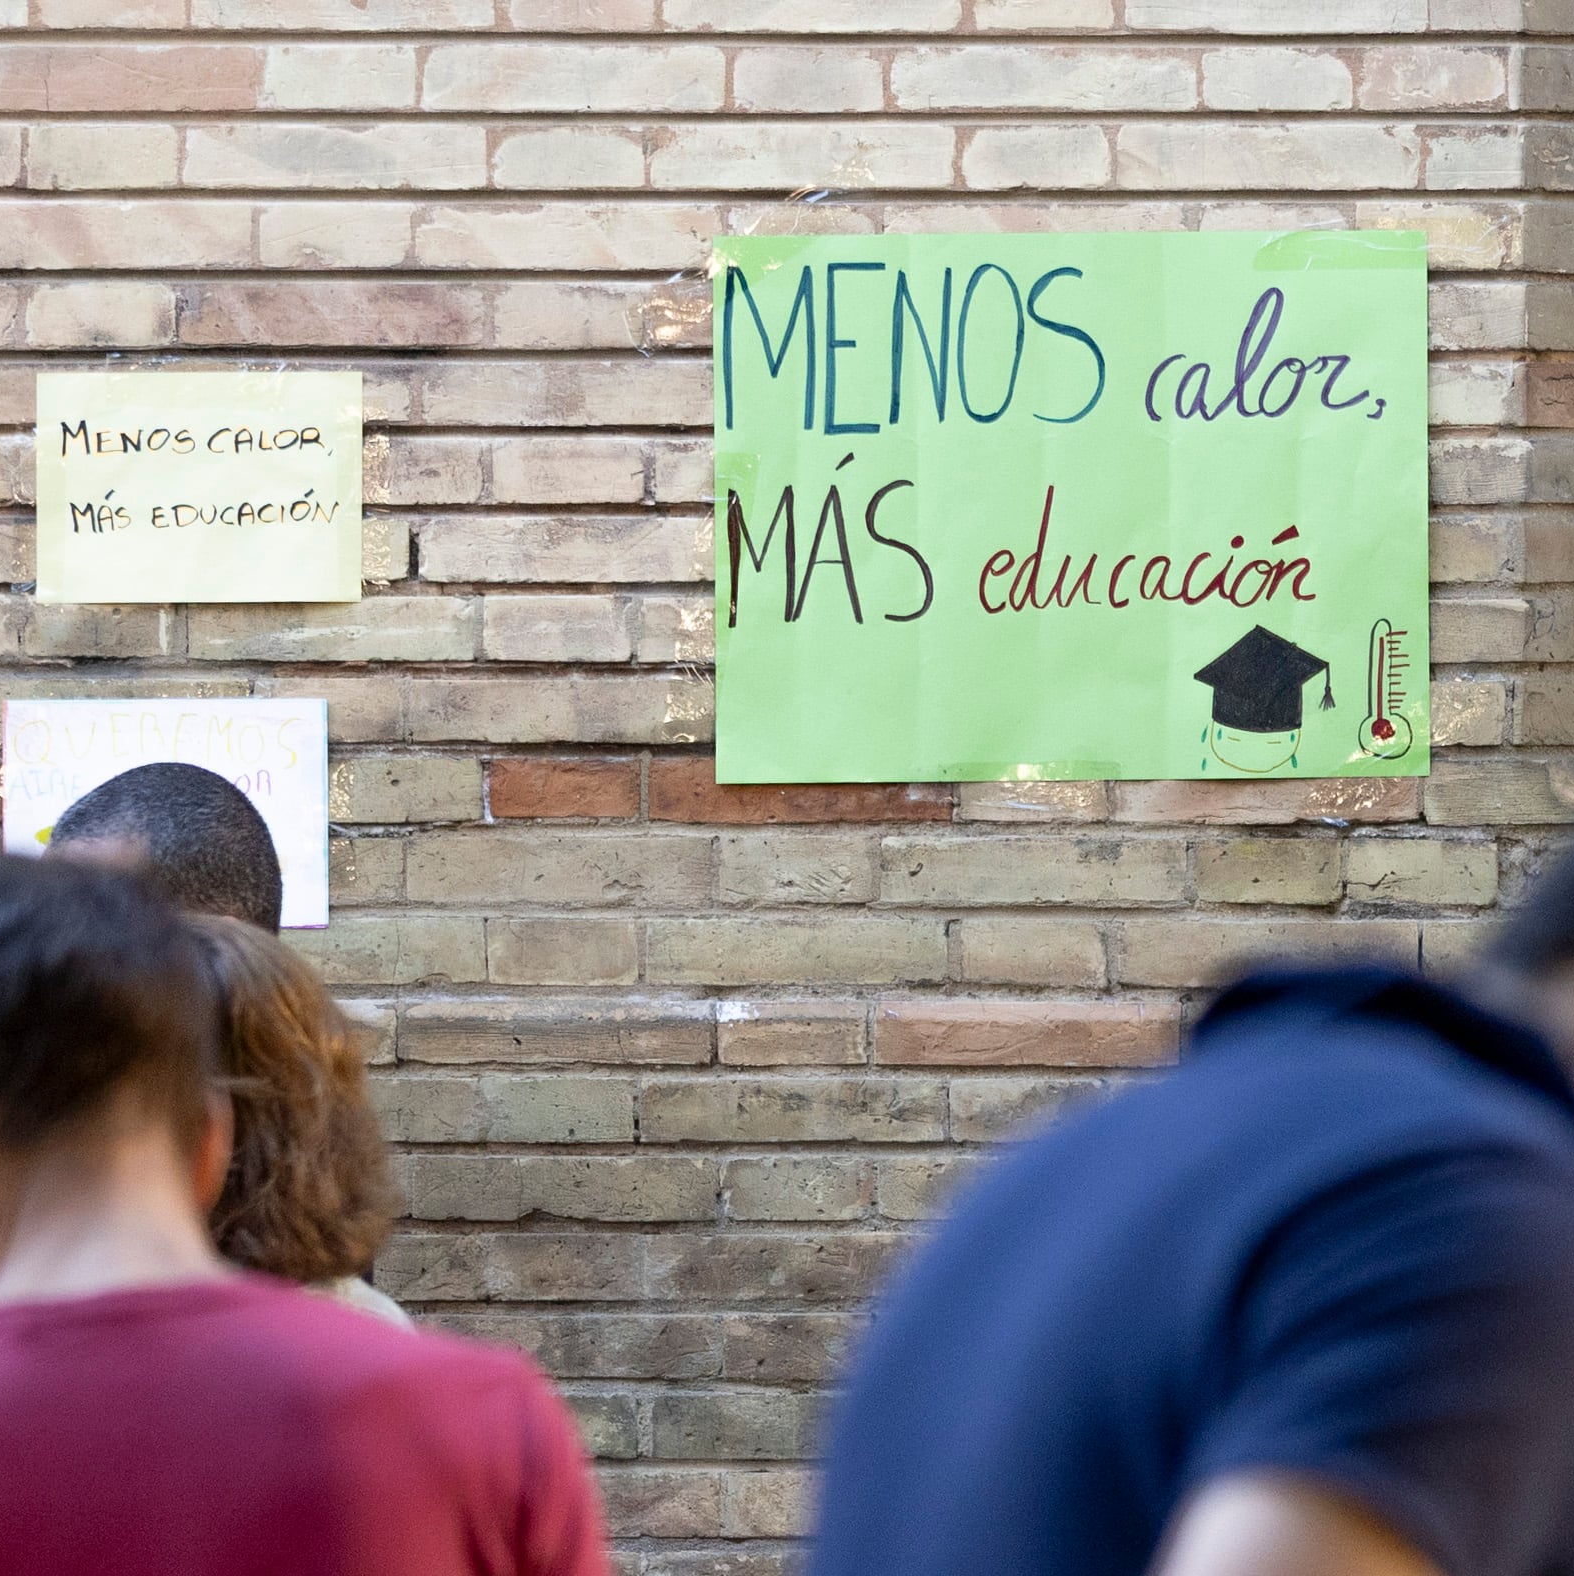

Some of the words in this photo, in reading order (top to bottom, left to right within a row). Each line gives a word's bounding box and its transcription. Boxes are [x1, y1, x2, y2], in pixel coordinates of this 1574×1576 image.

[723, 262, 1107, 435] MENOS
[1144, 286, 1388, 423] calor,
[61, 420, 196, 457] MENOS
[207, 426, 333, 457] CALOR,
[70, 489, 132, 533] MÁS
[151, 488, 340, 528] EDUCACIÓN
[727, 452, 935, 628] MÁS
[978, 484, 1317, 616] educación
[12, 711, 304, 770] QUEREMOS
